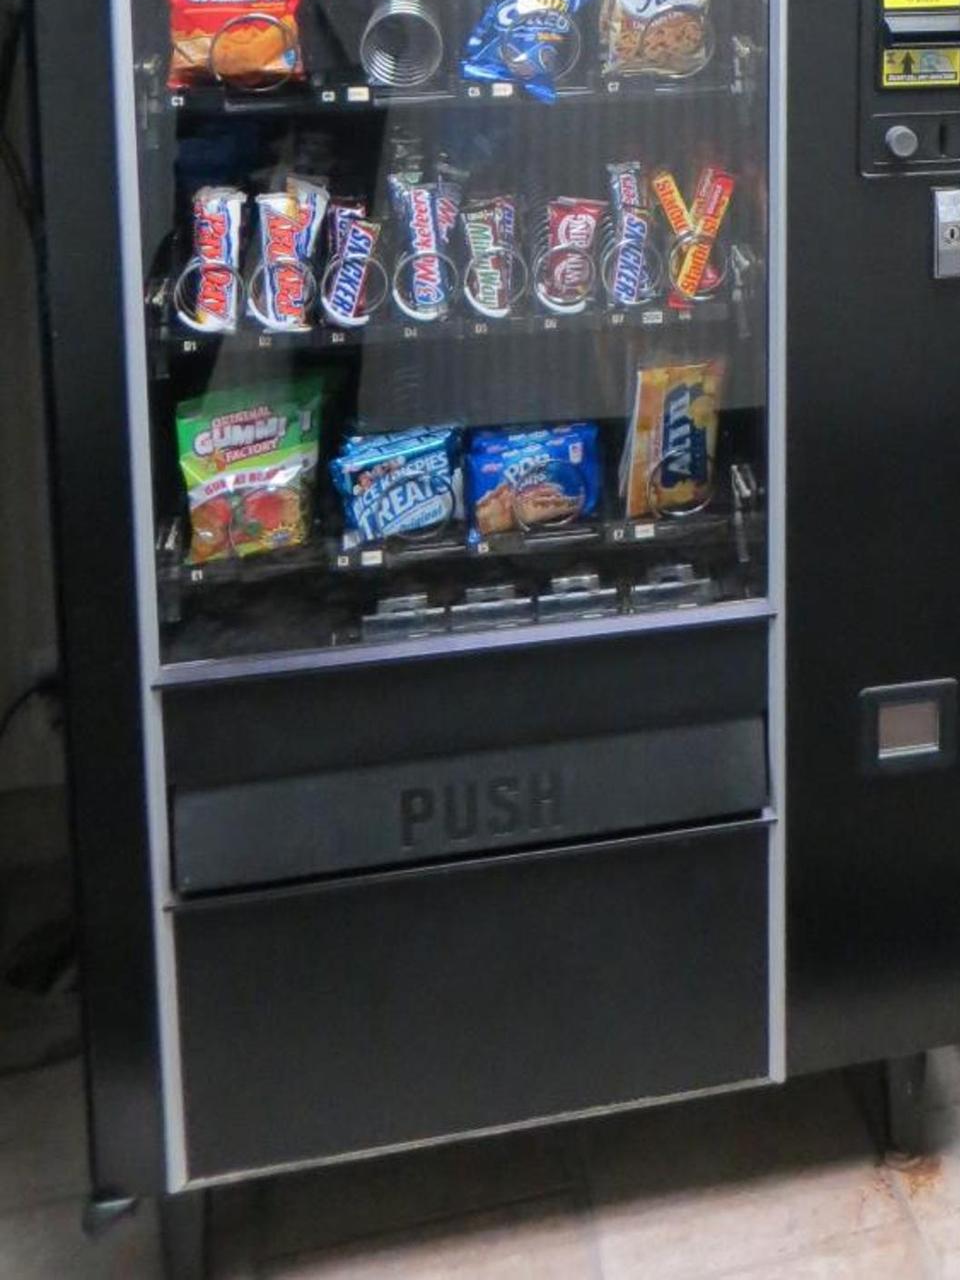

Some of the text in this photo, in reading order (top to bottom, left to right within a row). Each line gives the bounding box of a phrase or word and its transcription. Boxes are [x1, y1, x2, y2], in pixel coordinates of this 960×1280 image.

[409, 189, 440, 284] Muketeers
[224, 438, 279, 463] FACTORY
[358, 472, 451, 541] TREATS
[400, 770, 564, 850] PUSH
